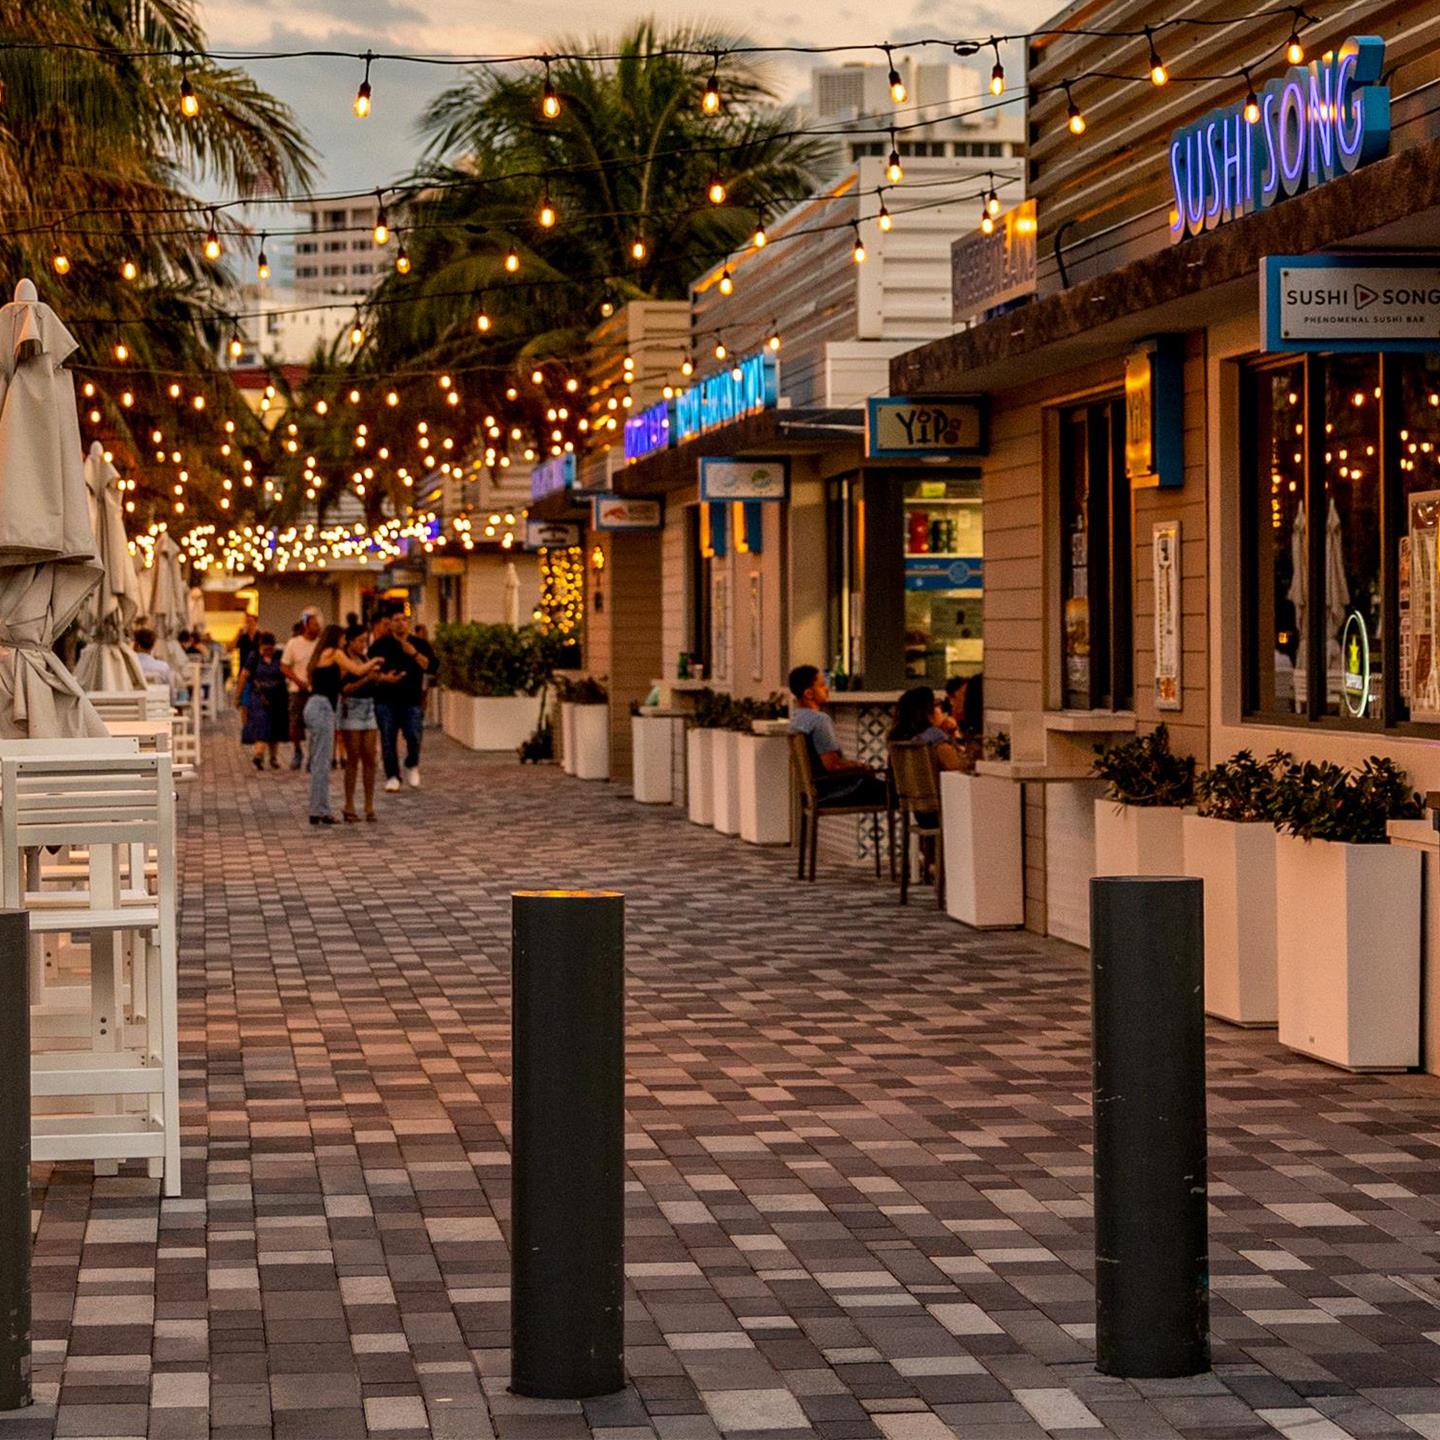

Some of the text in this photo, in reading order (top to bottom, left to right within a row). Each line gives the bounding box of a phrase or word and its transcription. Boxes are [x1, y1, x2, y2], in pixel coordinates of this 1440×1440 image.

[1169, 37, 1382, 245] SUSHI SONG
[1286, 289, 1348, 306] SUSHI
[1304, 315, 1425, 324] PHENOMENAL SUSHI BAR
